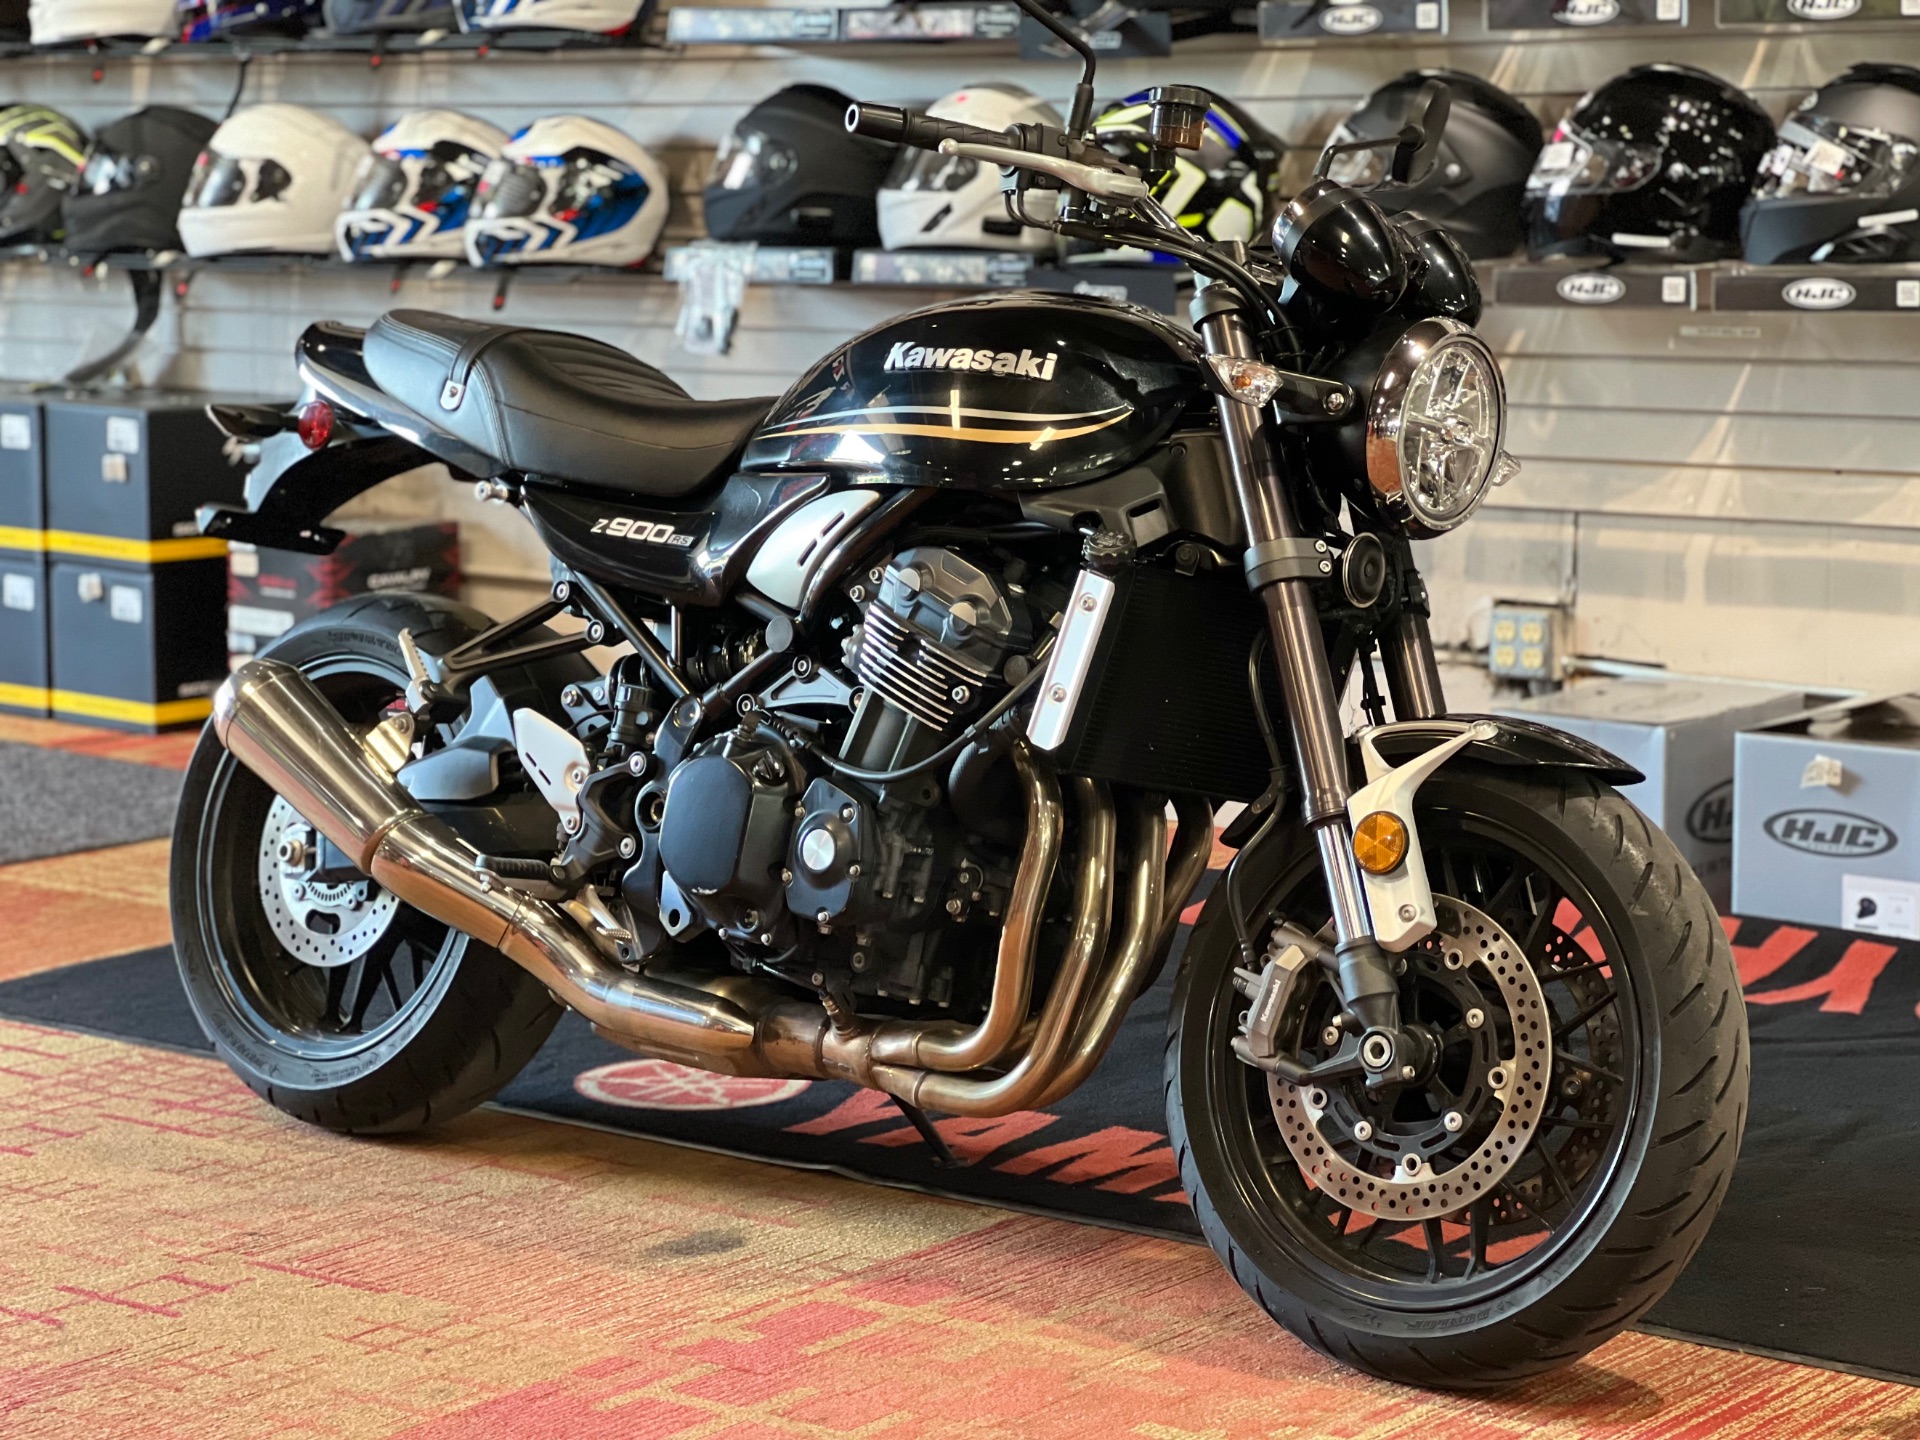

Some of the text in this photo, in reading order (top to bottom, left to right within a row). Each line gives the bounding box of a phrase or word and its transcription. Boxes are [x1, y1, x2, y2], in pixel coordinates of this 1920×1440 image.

[883, 341, 1058, 381] Kawasaki
[1781, 818, 1880, 848] HJC
[1260, 979, 1281, 1022] Kawasaki
